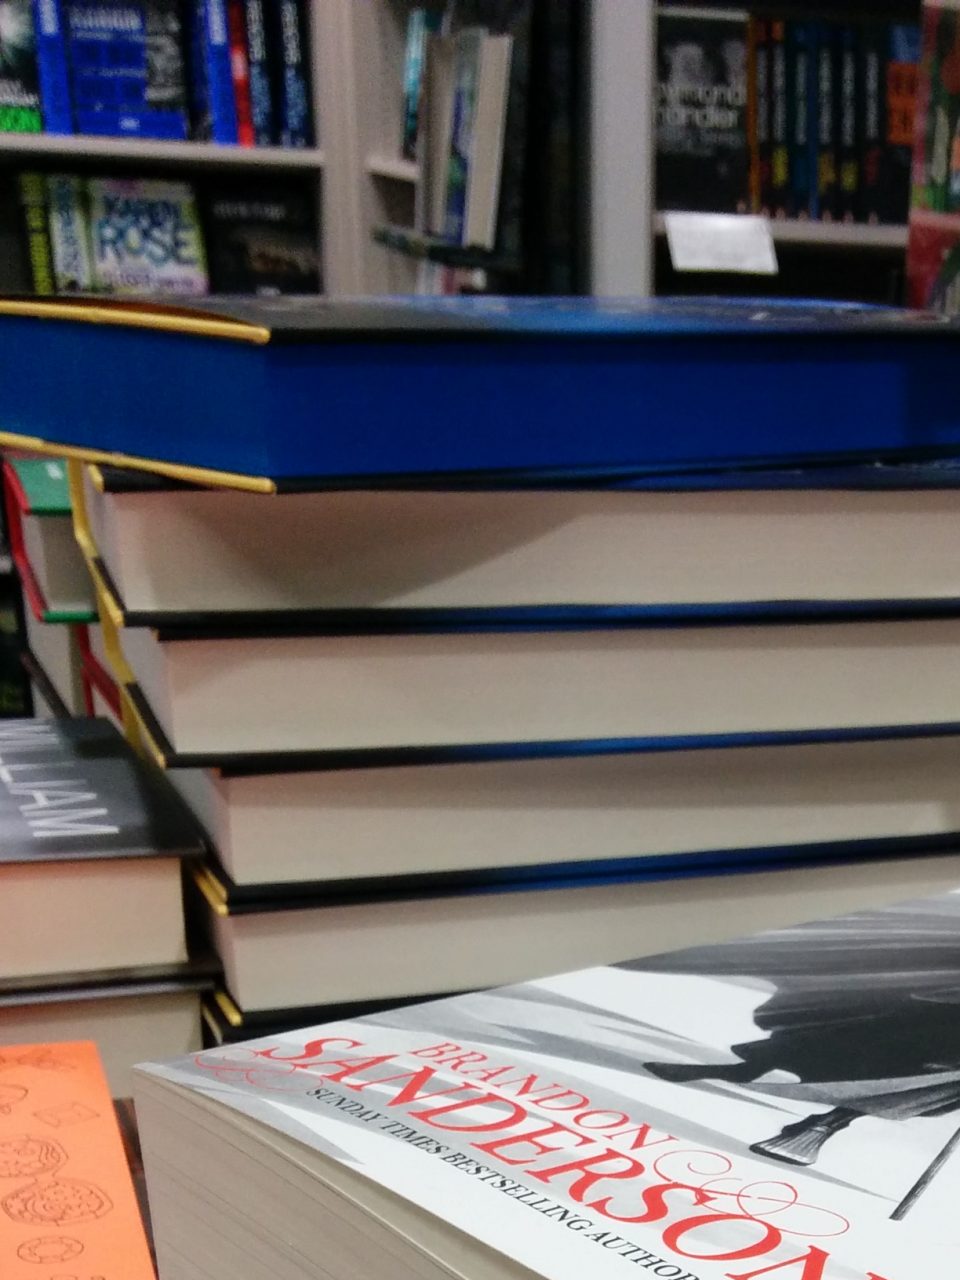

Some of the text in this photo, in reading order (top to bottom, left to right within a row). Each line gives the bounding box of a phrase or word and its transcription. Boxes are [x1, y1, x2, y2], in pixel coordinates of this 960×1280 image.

[408, 1042, 680, 1150] BRANDON
[305, 1087, 388, 1124] SUNDAY
[380, 1118, 450, 1162] TIMES
[442, 1151, 594, 1234] BESTSELLING
